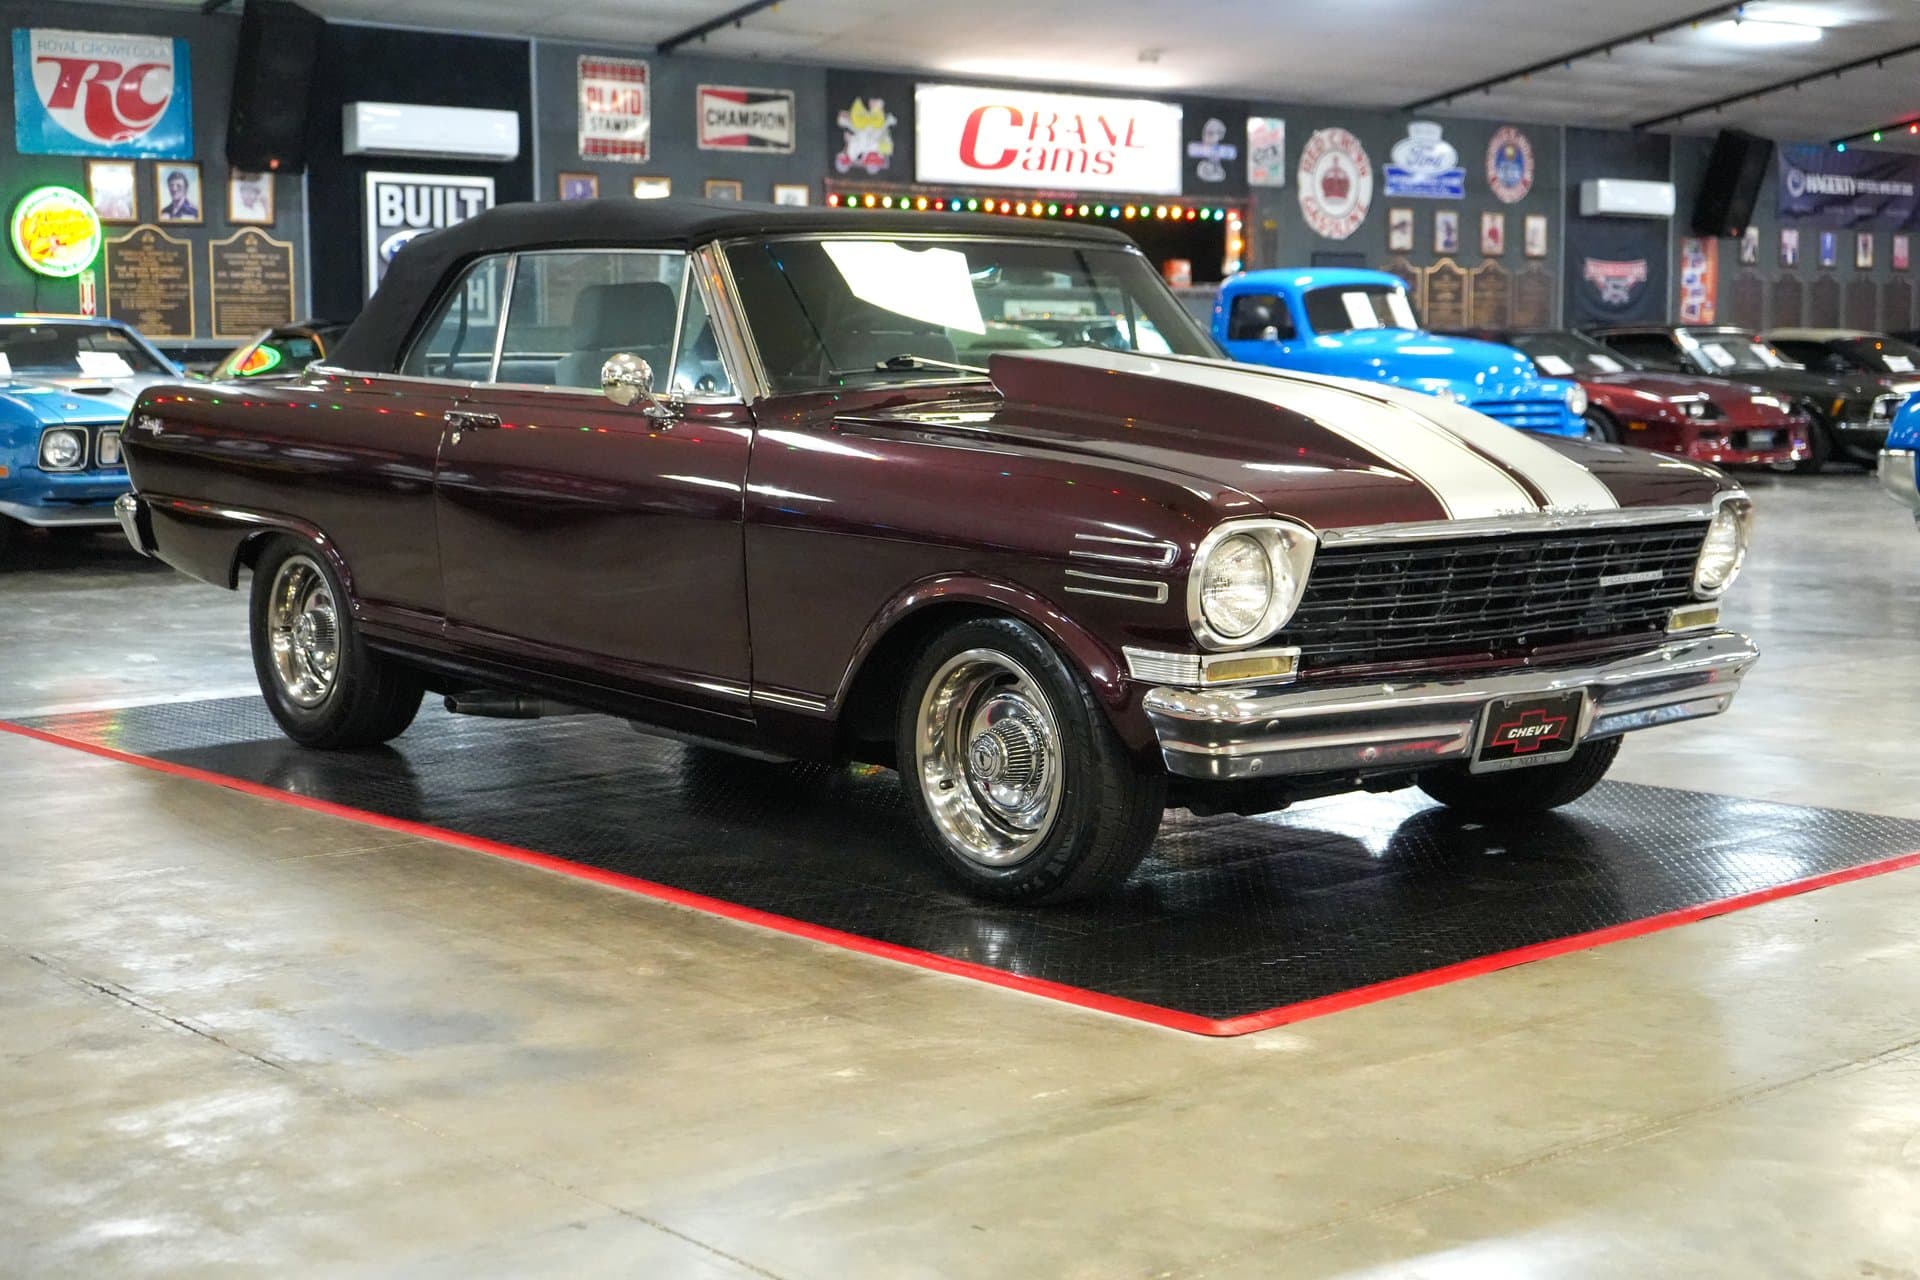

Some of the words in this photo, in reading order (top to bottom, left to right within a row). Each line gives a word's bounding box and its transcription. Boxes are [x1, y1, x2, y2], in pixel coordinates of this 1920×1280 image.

[37, 40, 78, 53] ROYAL
[82, 41, 128, 56] CROWN
[37, 56, 171, 142] RC
[587, 87, 641, 115] PLAID
[706, 109, 785, 130] CHAMPION
[378, 184, 485, 228] BUILT
[1507, 724, 1553, 740] CHEVY
